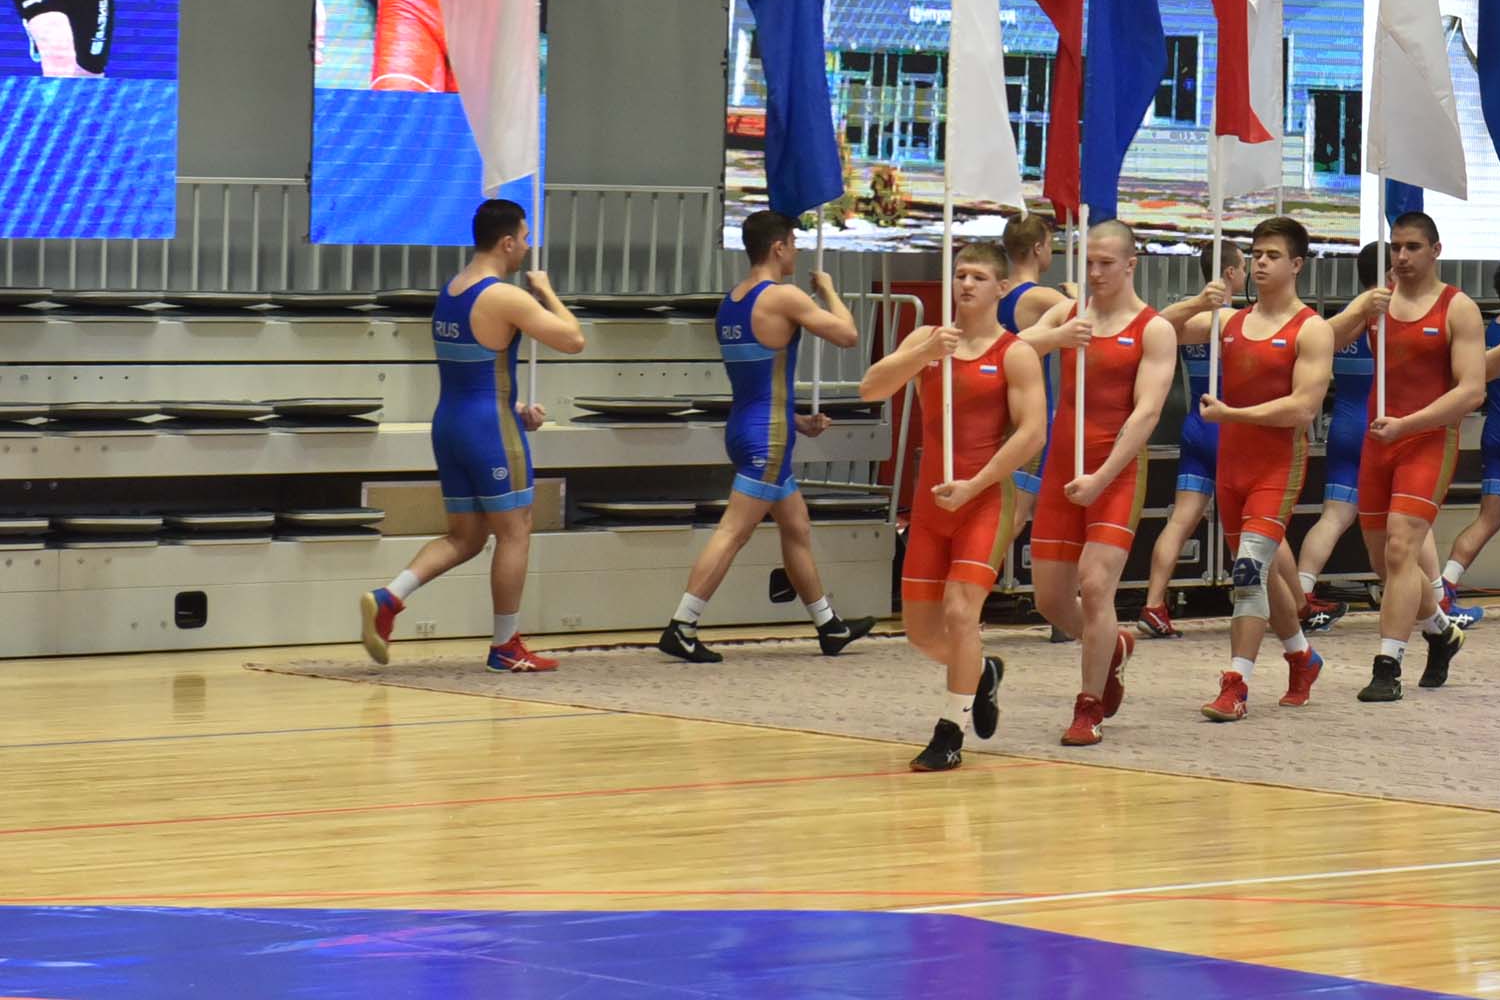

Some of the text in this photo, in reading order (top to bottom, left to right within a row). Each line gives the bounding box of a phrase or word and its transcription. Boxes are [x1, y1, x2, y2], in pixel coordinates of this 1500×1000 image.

[435, 320, 461, 339] RUS
[722, 324, 742, 340] RUS
[1337, 341, 1359, 355] US
